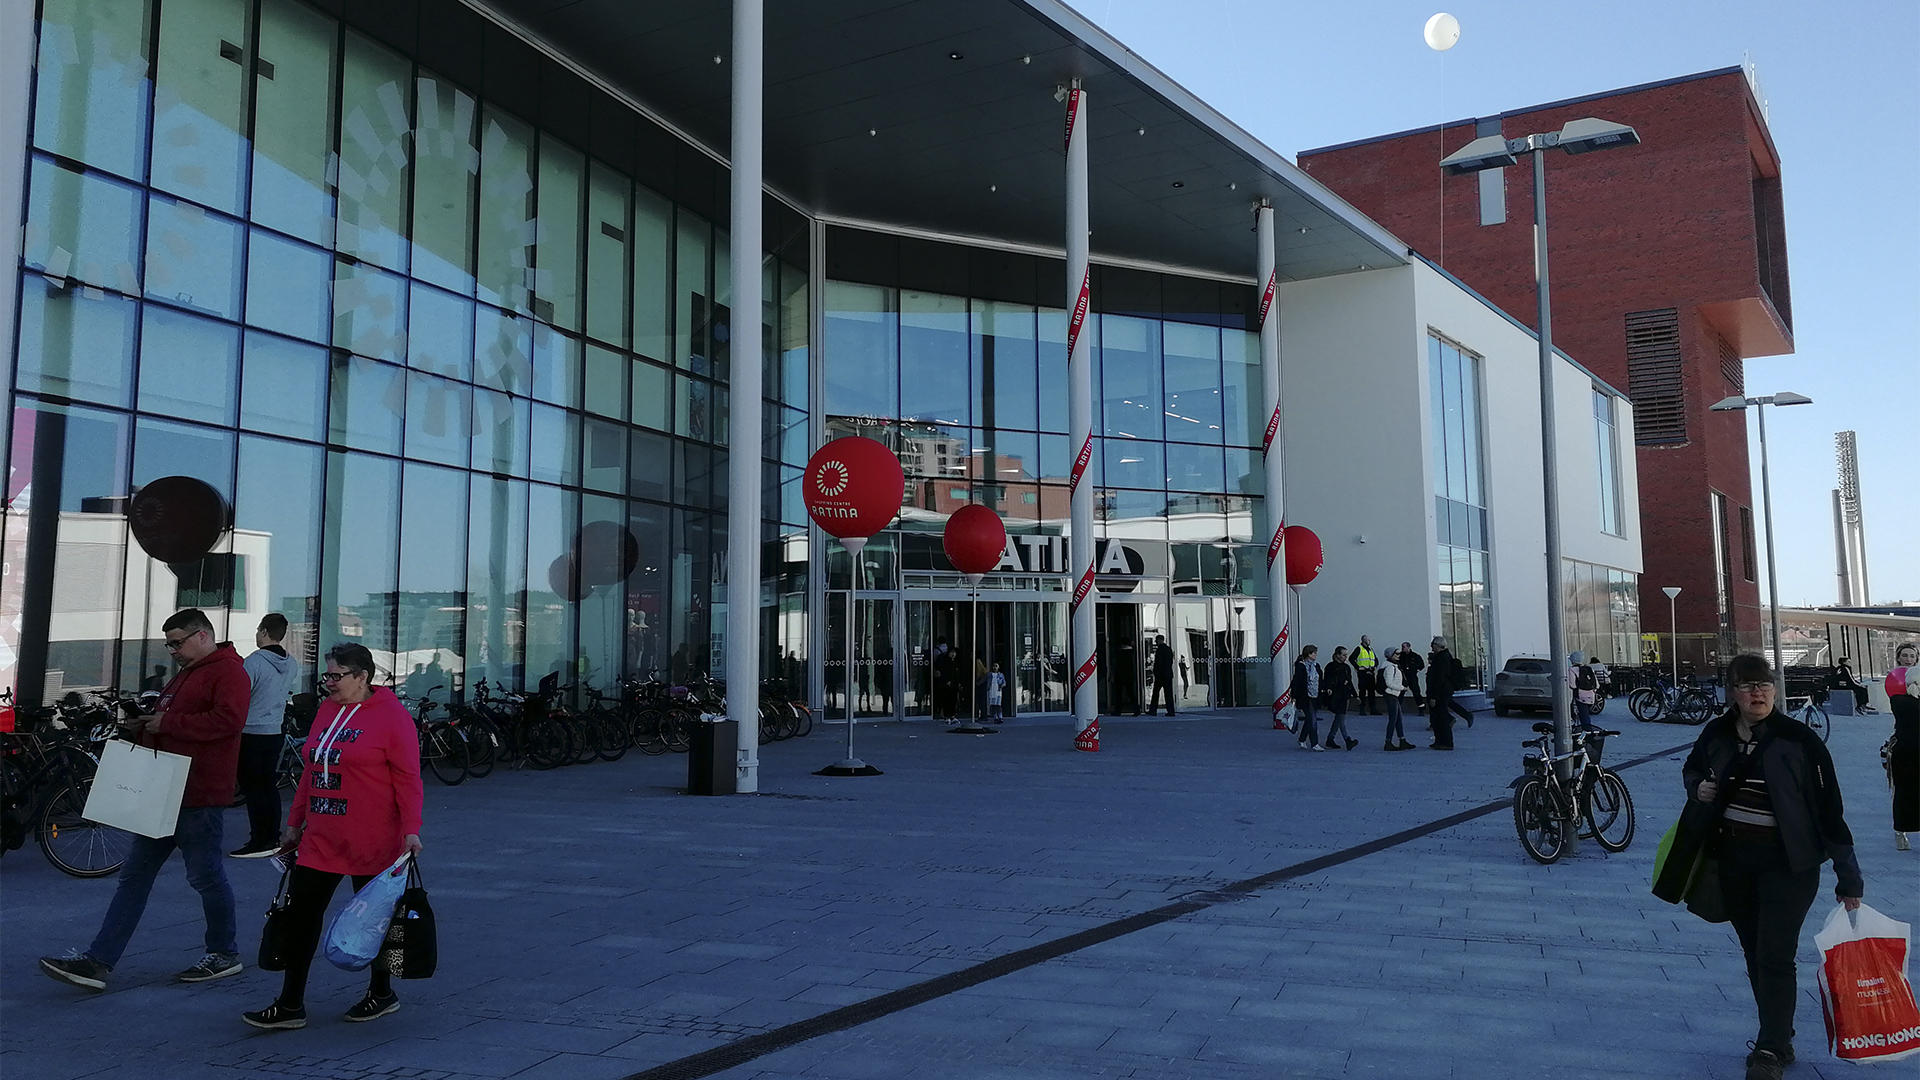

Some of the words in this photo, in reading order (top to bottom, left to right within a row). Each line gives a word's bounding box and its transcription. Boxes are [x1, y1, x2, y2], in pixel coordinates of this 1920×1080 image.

[1073, 296, 1087, 326] RATINA
[811, 505, 858, 518] RATINA
[1073, 579, 1091, 606] RATINA
[1842, 1033, 1886, 1050] HONG
[1886, 1026, 1920, 1046] KONG
